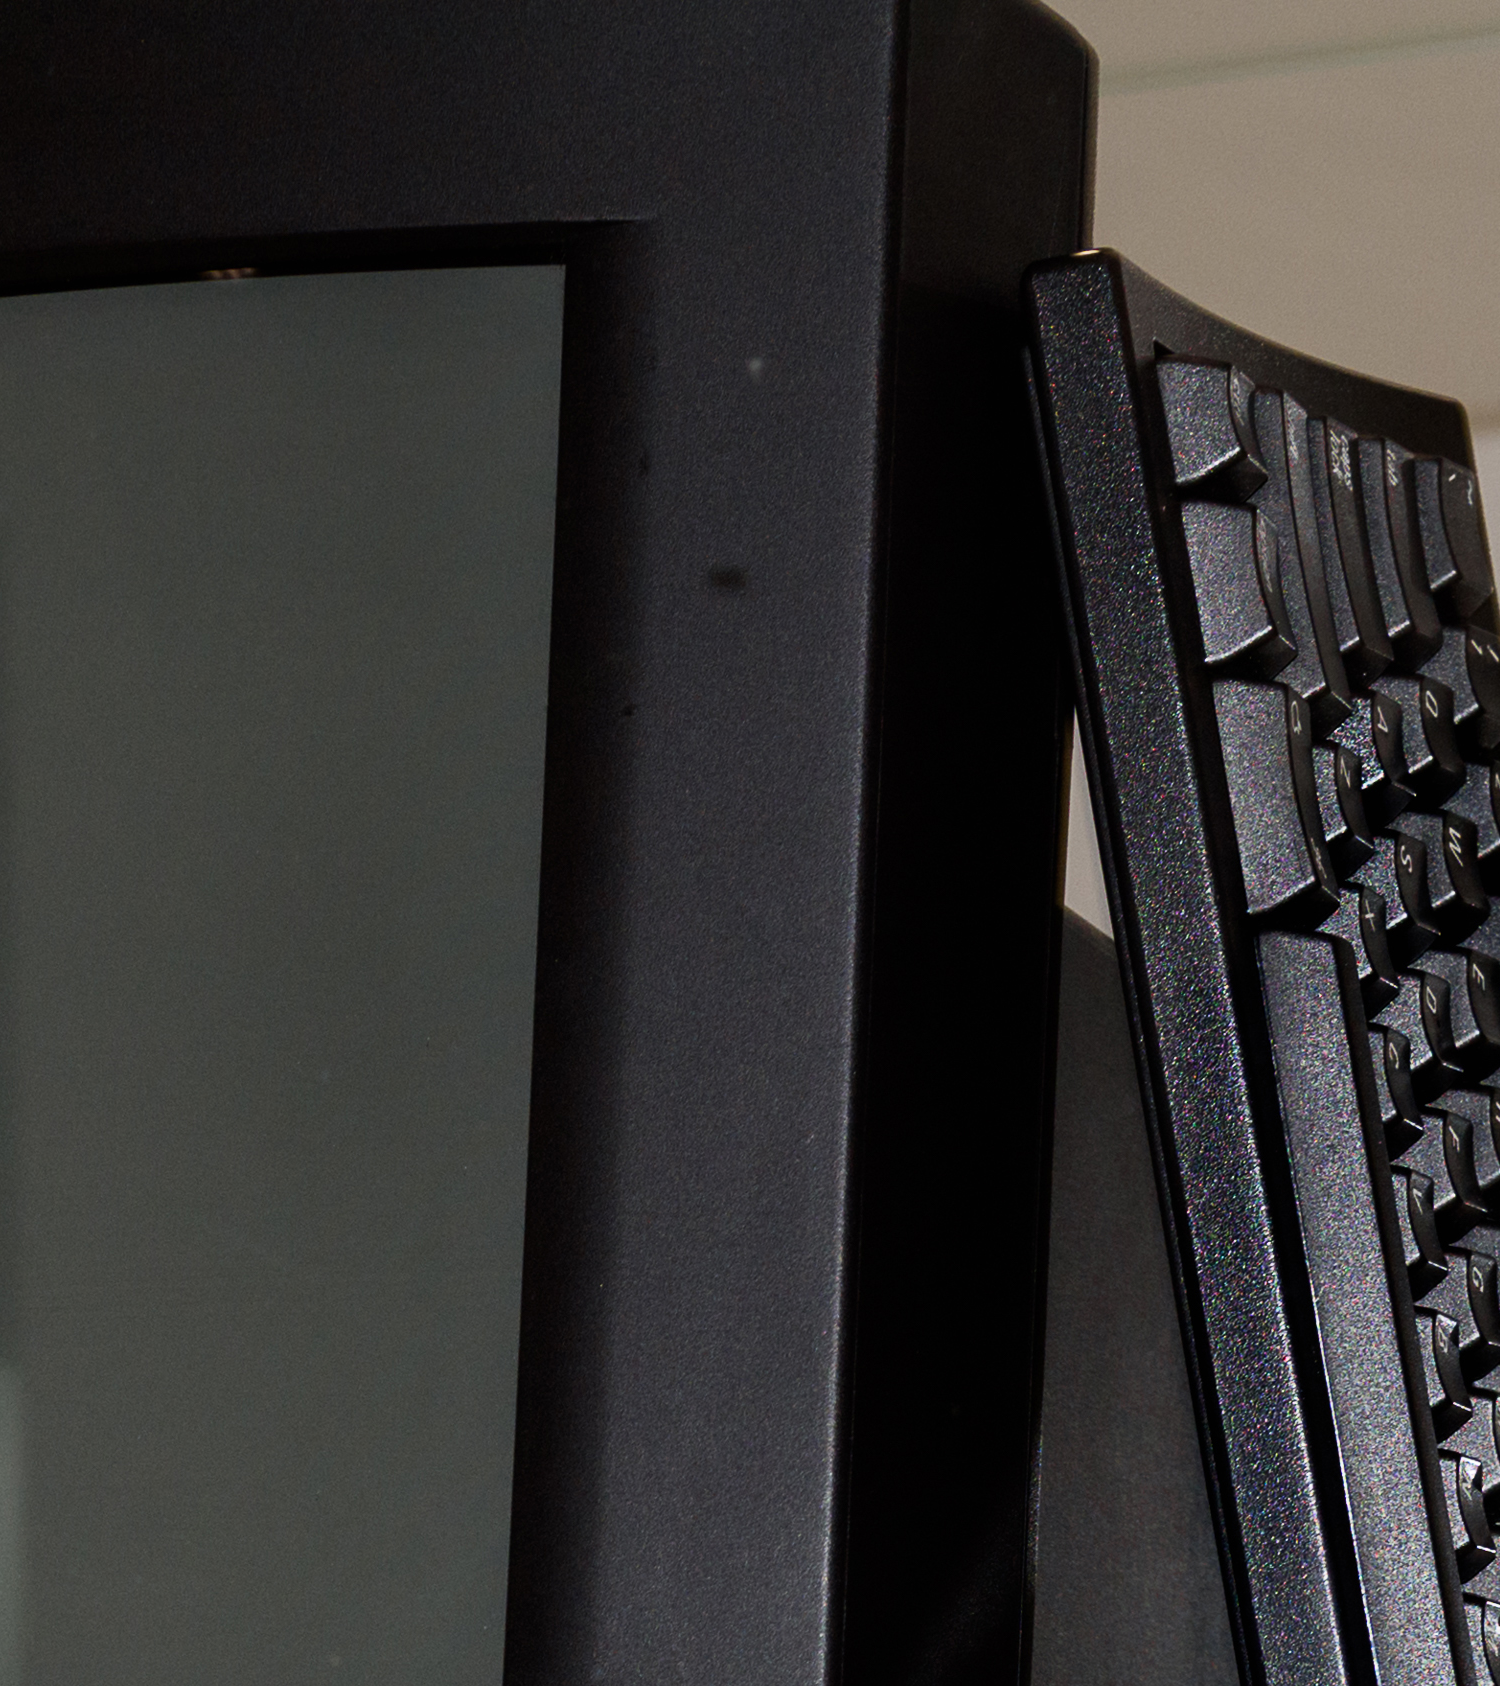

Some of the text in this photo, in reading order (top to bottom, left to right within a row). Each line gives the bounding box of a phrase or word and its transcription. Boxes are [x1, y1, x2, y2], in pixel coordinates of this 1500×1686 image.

[1377, 706, 1389, 734] A
[1340, 756, 1351, 788] Z
[1400, 845, 1413, 873] S
[1449, 827, 1464, 868] W
[1472, 963, 1486, 992] E
[1426, 985, 1437, 1014] D
[1389, 1042, 1400, 1070] C
[1448, 1125, 1460, 1153] F
[1472, 1266, 1484, 1293] G
